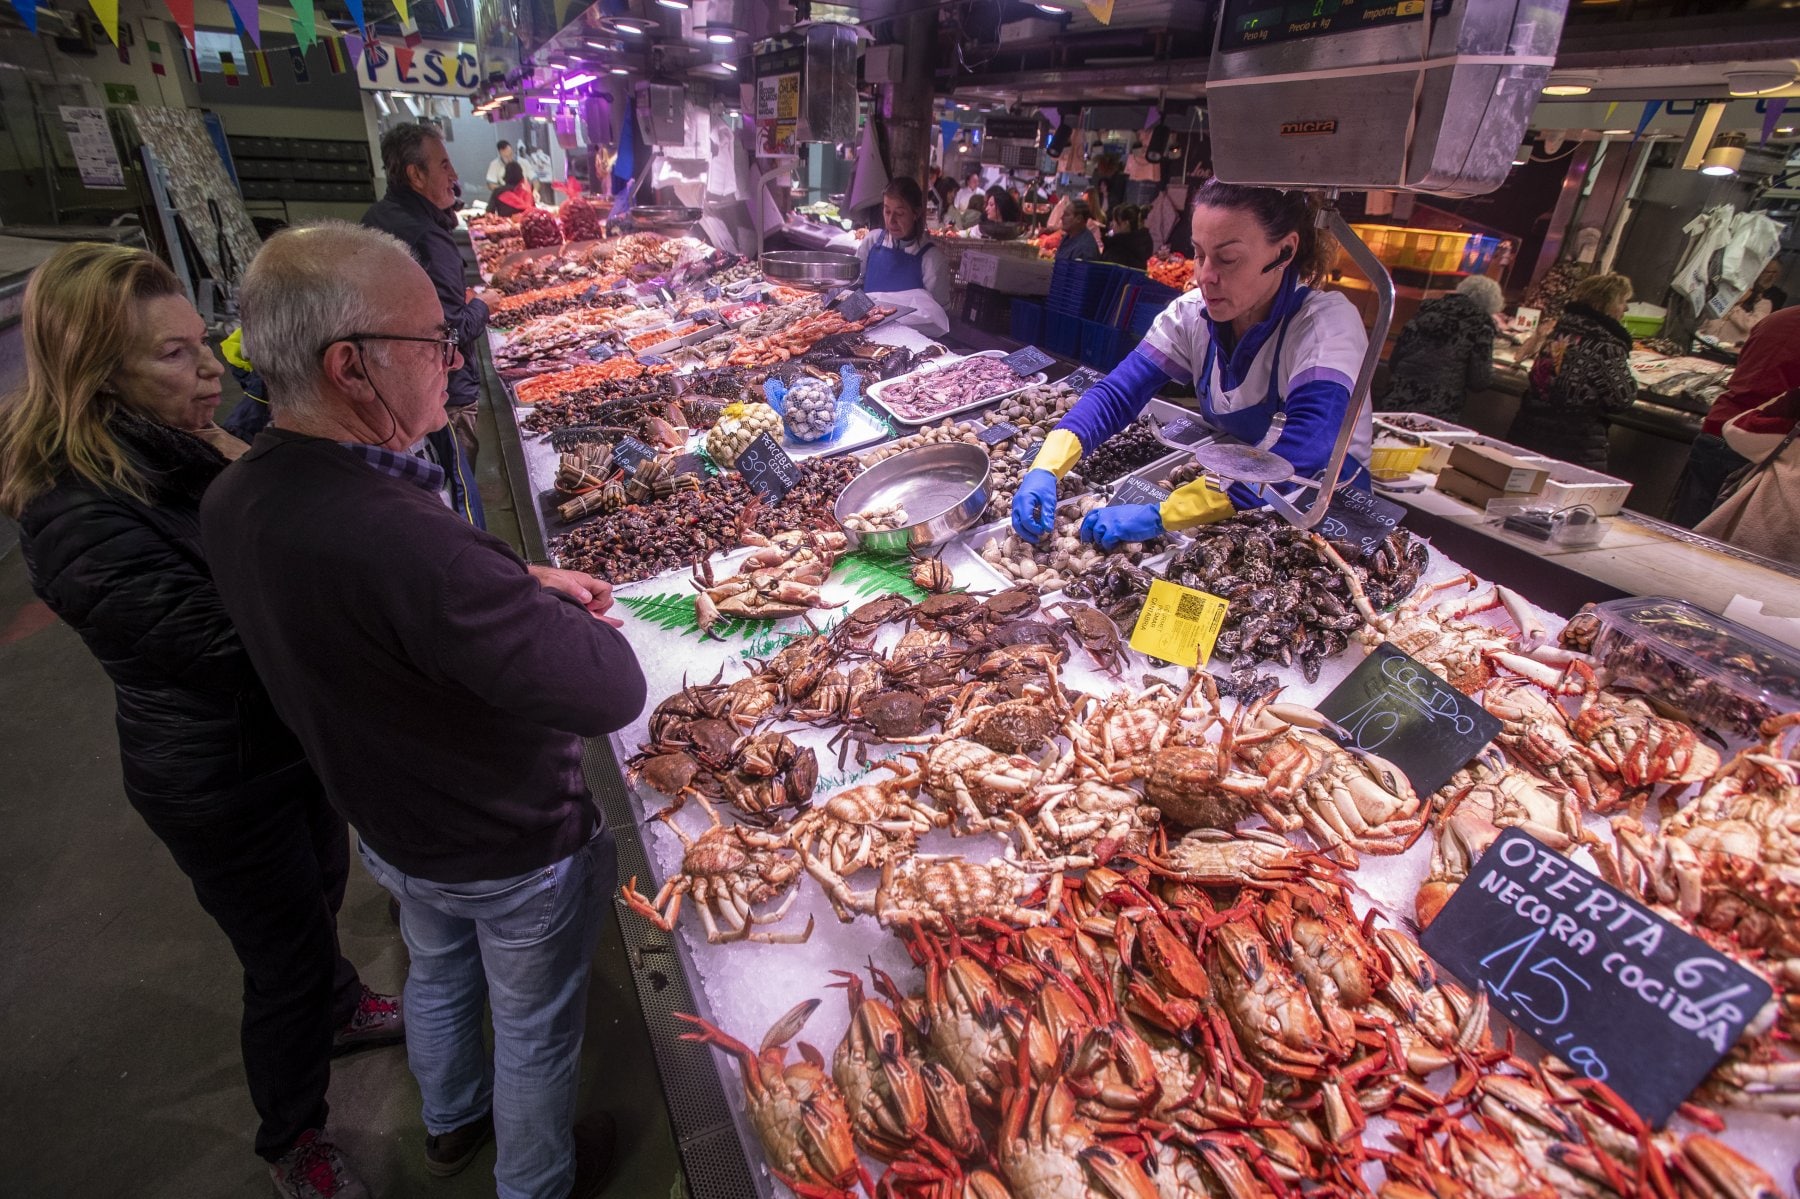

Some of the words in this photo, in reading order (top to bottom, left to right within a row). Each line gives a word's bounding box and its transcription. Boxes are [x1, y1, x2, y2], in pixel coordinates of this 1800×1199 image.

[1289, 21, 1310, 32] Precio
[1320, 17, 1331, 29] kg
[1363, 6, 1396, 20] Importe
[1243, 31, 1258, 40] Peso
[1259, 29, 1268, 39] kg
[1280, 120, 1336, 134] micra
[762, 433, 792, 469] PERCEBE
[768, 459, 793, 488] CEDEIRA
[1344, 500, 1396, 526] GALLEGO
[1140, 597, 1158, 630] CANTABRIA
[1381, 656, 1475, 734] COCIDO
[1500, 837, 1664, 957] OFERTA
[1479, 870, 1596, 956] NECORA
[1602, 951, 1729, 1054] COCIDA
